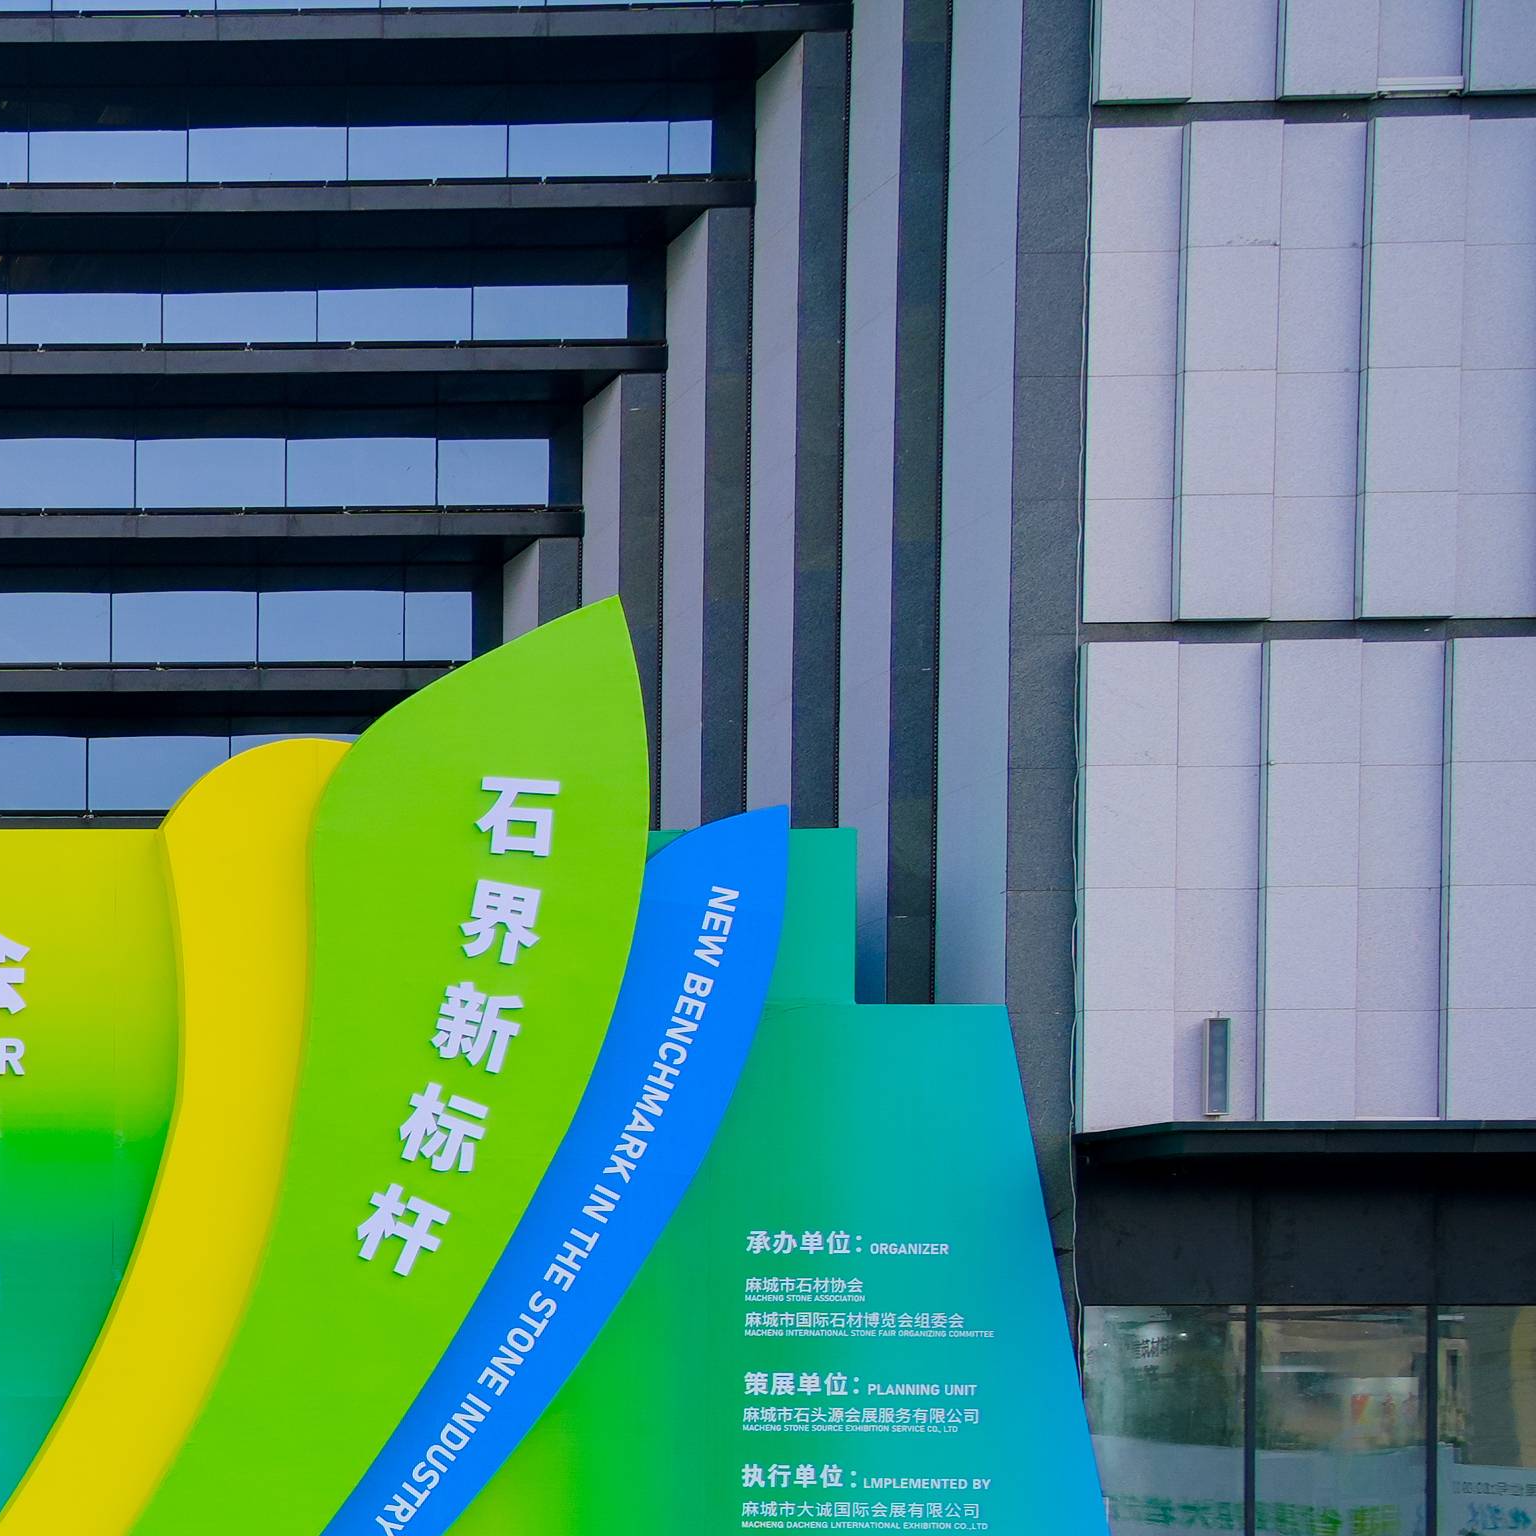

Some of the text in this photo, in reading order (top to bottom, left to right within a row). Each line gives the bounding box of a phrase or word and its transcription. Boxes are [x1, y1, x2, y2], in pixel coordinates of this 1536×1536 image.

[694, 886, 740, 967] NEW
[356, 775, 561, 1277] 石界新标杆
[603, 972, 714, 1183] BENCHMARK
[582, 1184, 621, 1224] IN
[746, 1231, 949, 1255] 承办单位： ORGANIZER
[543, 1228, 600, 1292] THE
[746, 1277, 863, 1293] 麻城市石材协会
[745, 1312, 964, 1330] 麻城市国际石材博览会组委会
[477, 1291, 557, 1396] STONE
[744, 1372, 977, 1396] 策展单位： PLANNING UNIT
[743, 1407, 978, 1424] 麻城市石头源会展服务有限公司
[742, 1464, 856, 1488] 执行单位：
[972, 1478, 992, 1490] BY
[742, 1501, 979, 1518] 麻城市大诚国际会展有限公司
